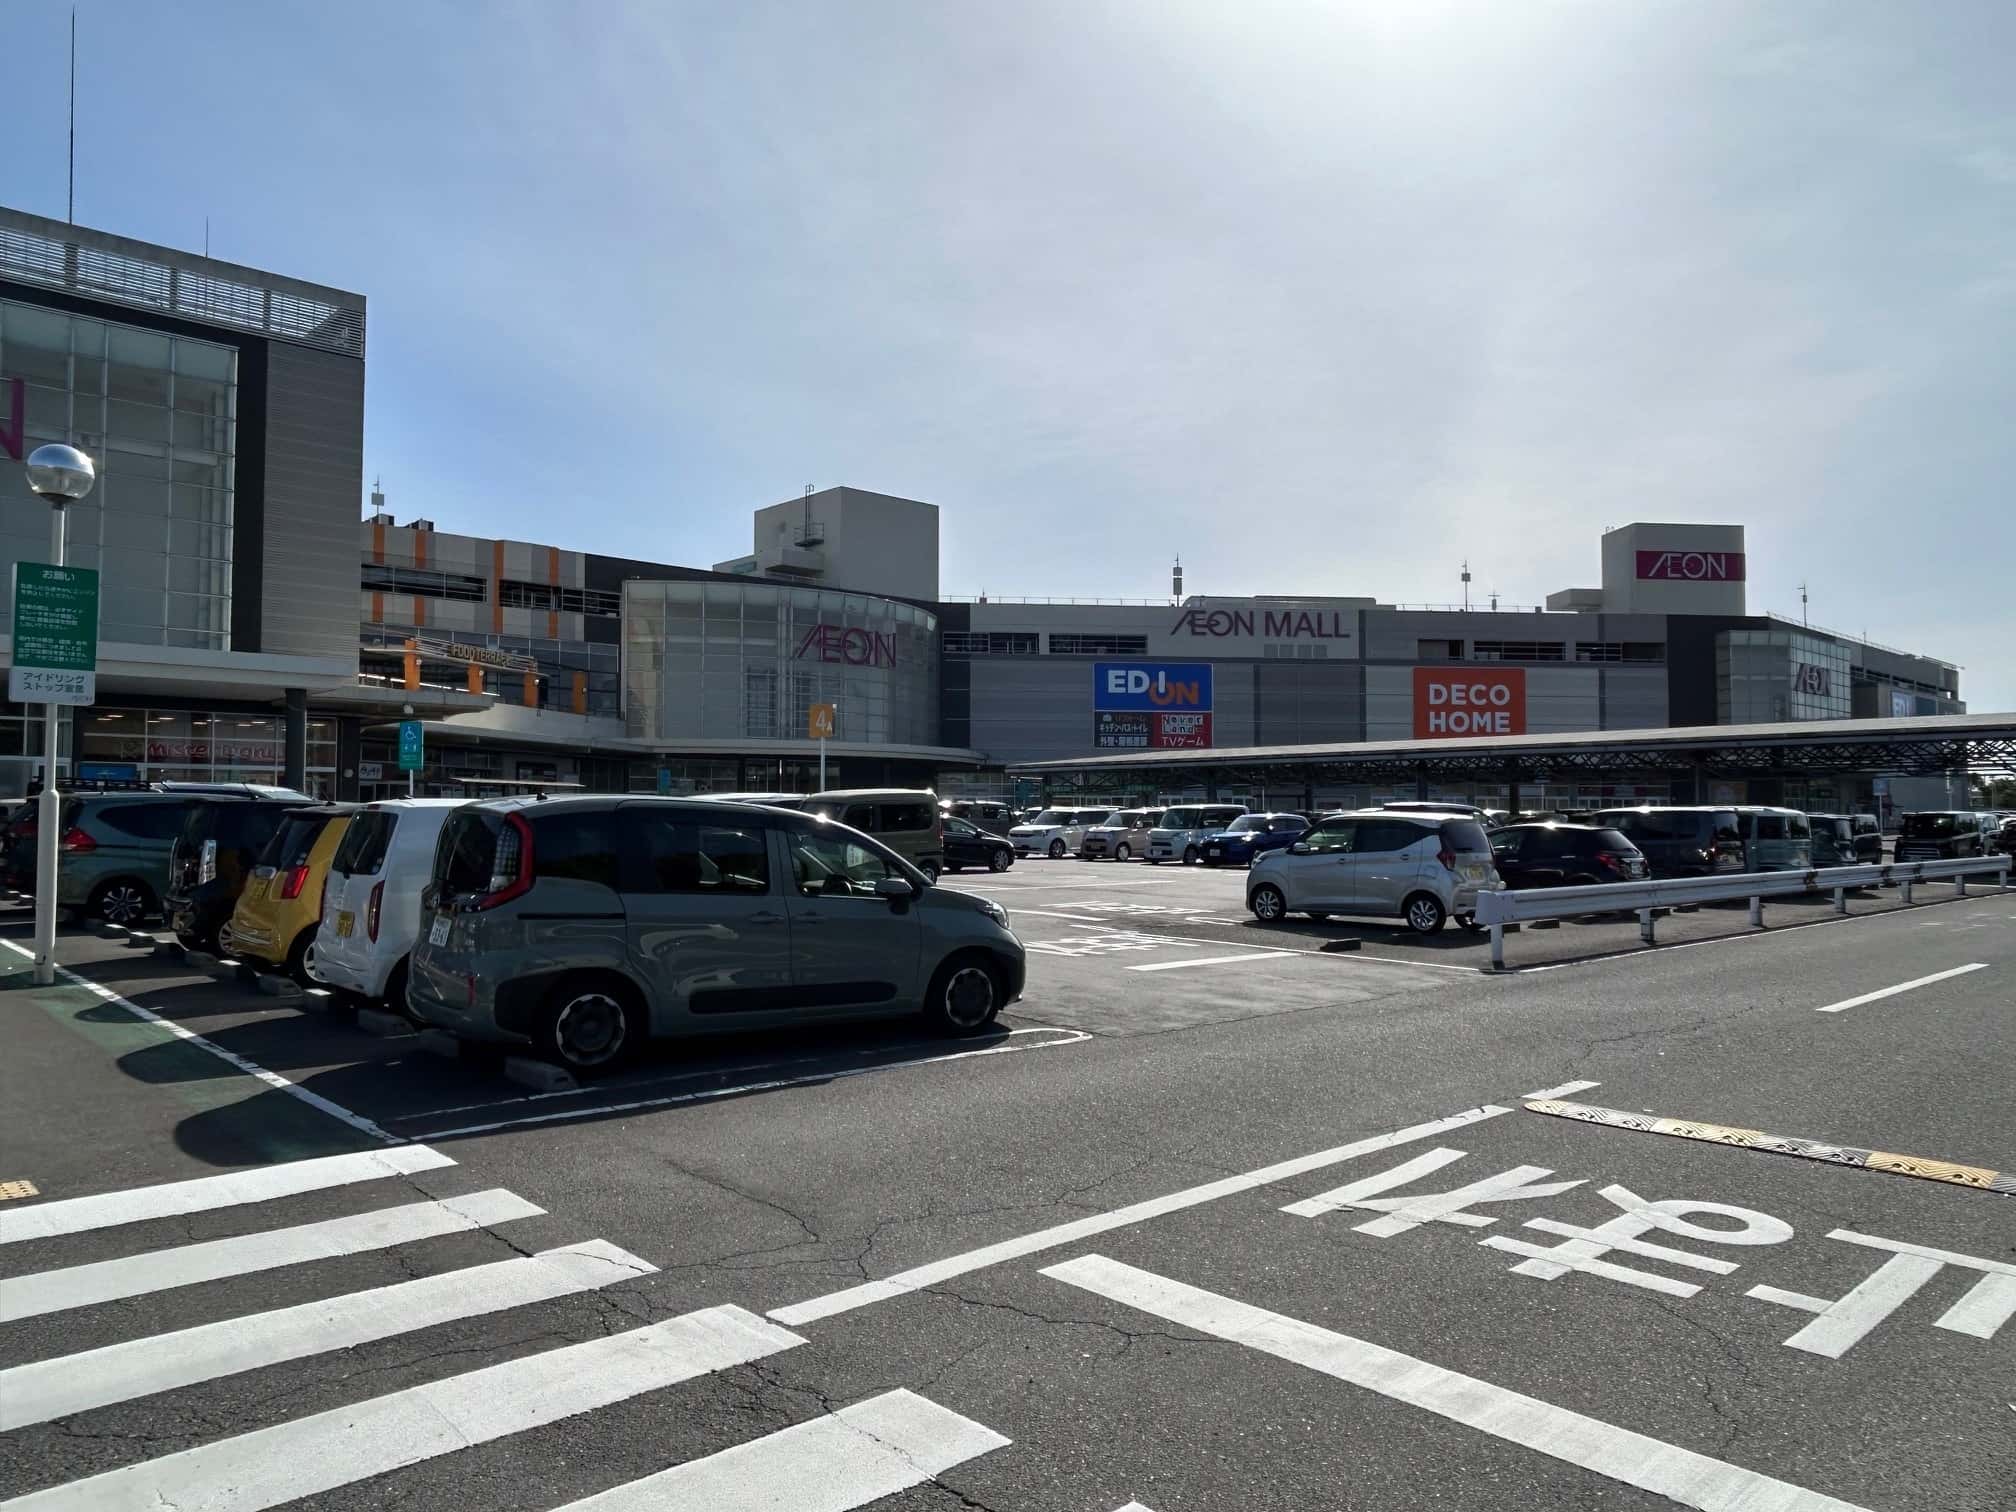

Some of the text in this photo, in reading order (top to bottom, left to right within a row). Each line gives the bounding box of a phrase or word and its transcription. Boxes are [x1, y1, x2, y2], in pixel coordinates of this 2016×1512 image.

[1264, 611, 1350, 638] MALL
[453, 643, 475, 662] FOOD
[23, 672, 85, 684] アイドリング
[1107, 669, 1199, 705] EDION
[1428, 683, 1510, 706] DECO
[1429, 711, 1511, 733] HOME
[1280, 1146, 2016, 1360] 止まれ
